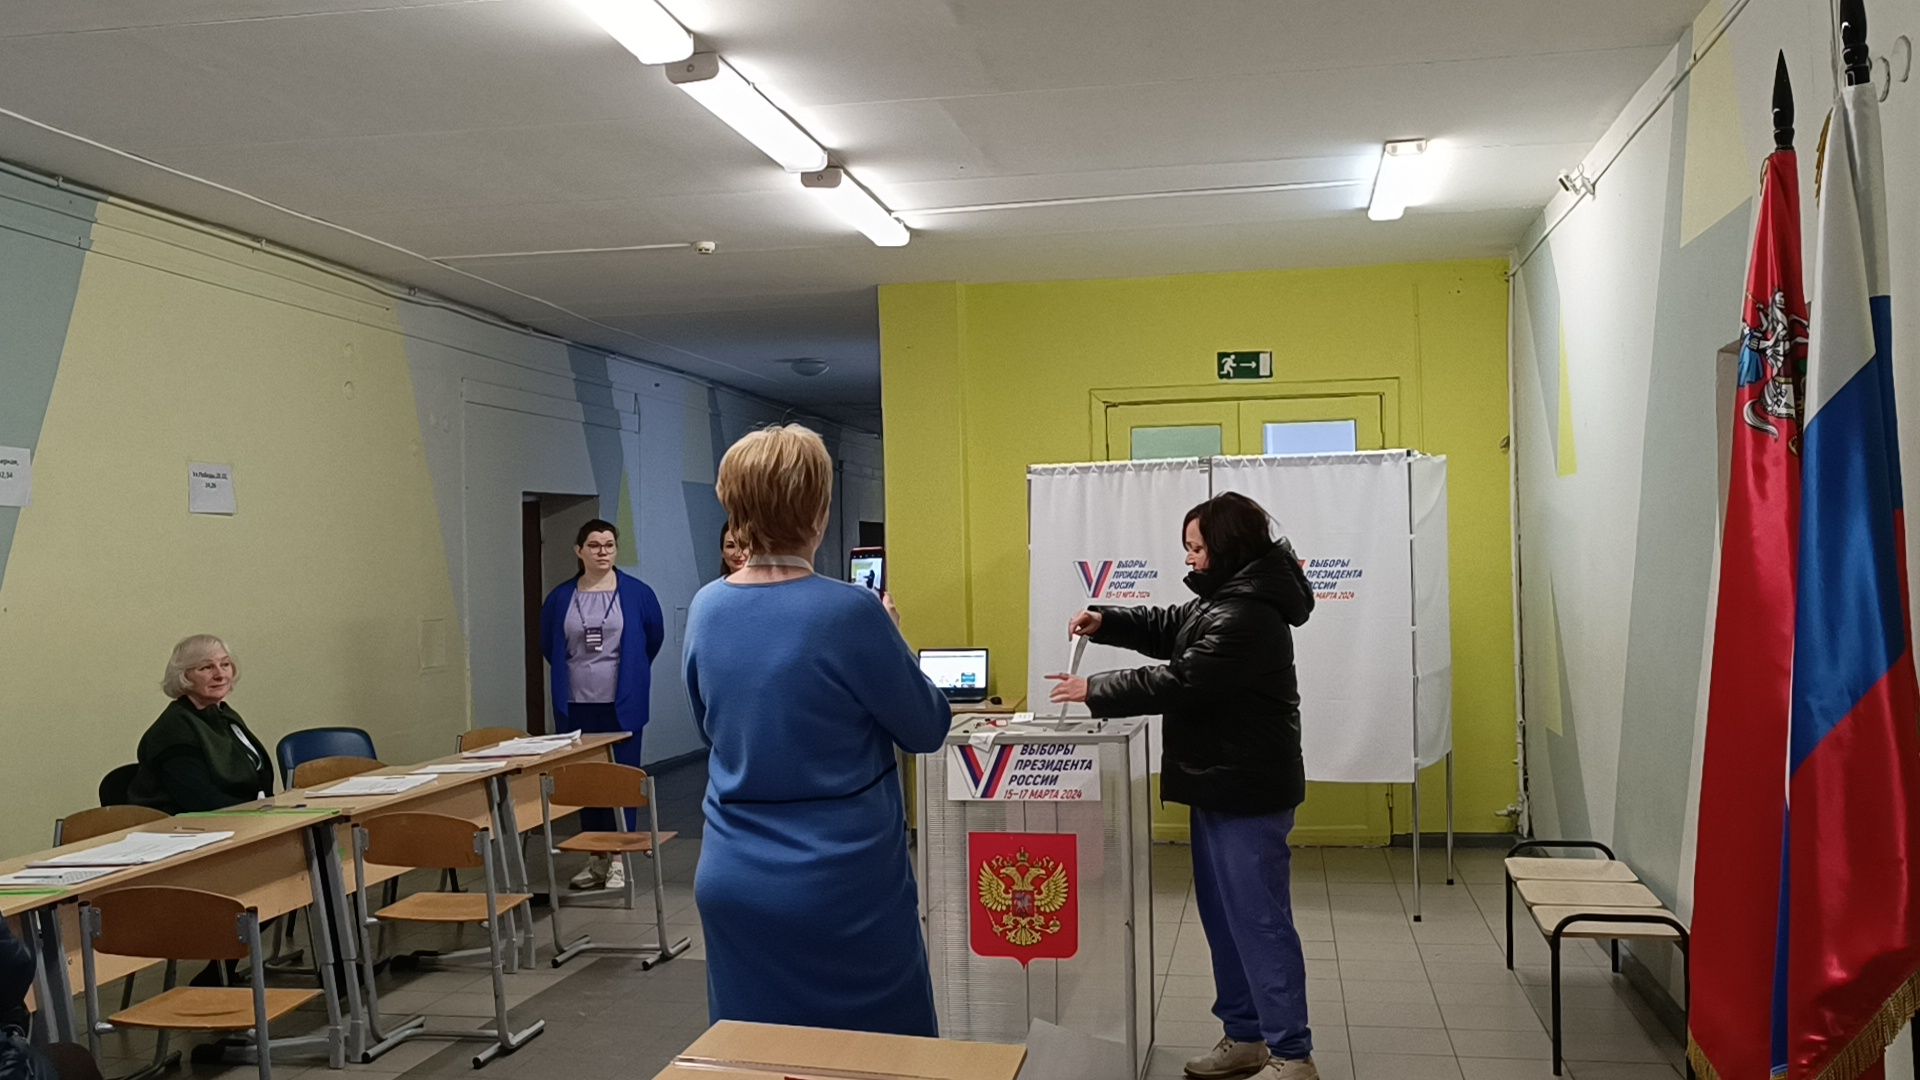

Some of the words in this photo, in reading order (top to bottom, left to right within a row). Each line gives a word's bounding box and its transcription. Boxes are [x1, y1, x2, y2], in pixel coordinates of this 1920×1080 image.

[1310, 559, 1350, 567] ВЫБОРЫ
[1306, 570, 1362, 579] ПРЕЗИДЕНТА
[1020, 744, 1076, 756] ВЫБОРЫ
[1014, 759, 1093, 772] ПРЕЗИДЕНТА
[1008, 774, 1059, 786] РОССИИ
[1028, 788, 1060, 800] МАРТА
[1060, 788, 1083, 800] 2024
